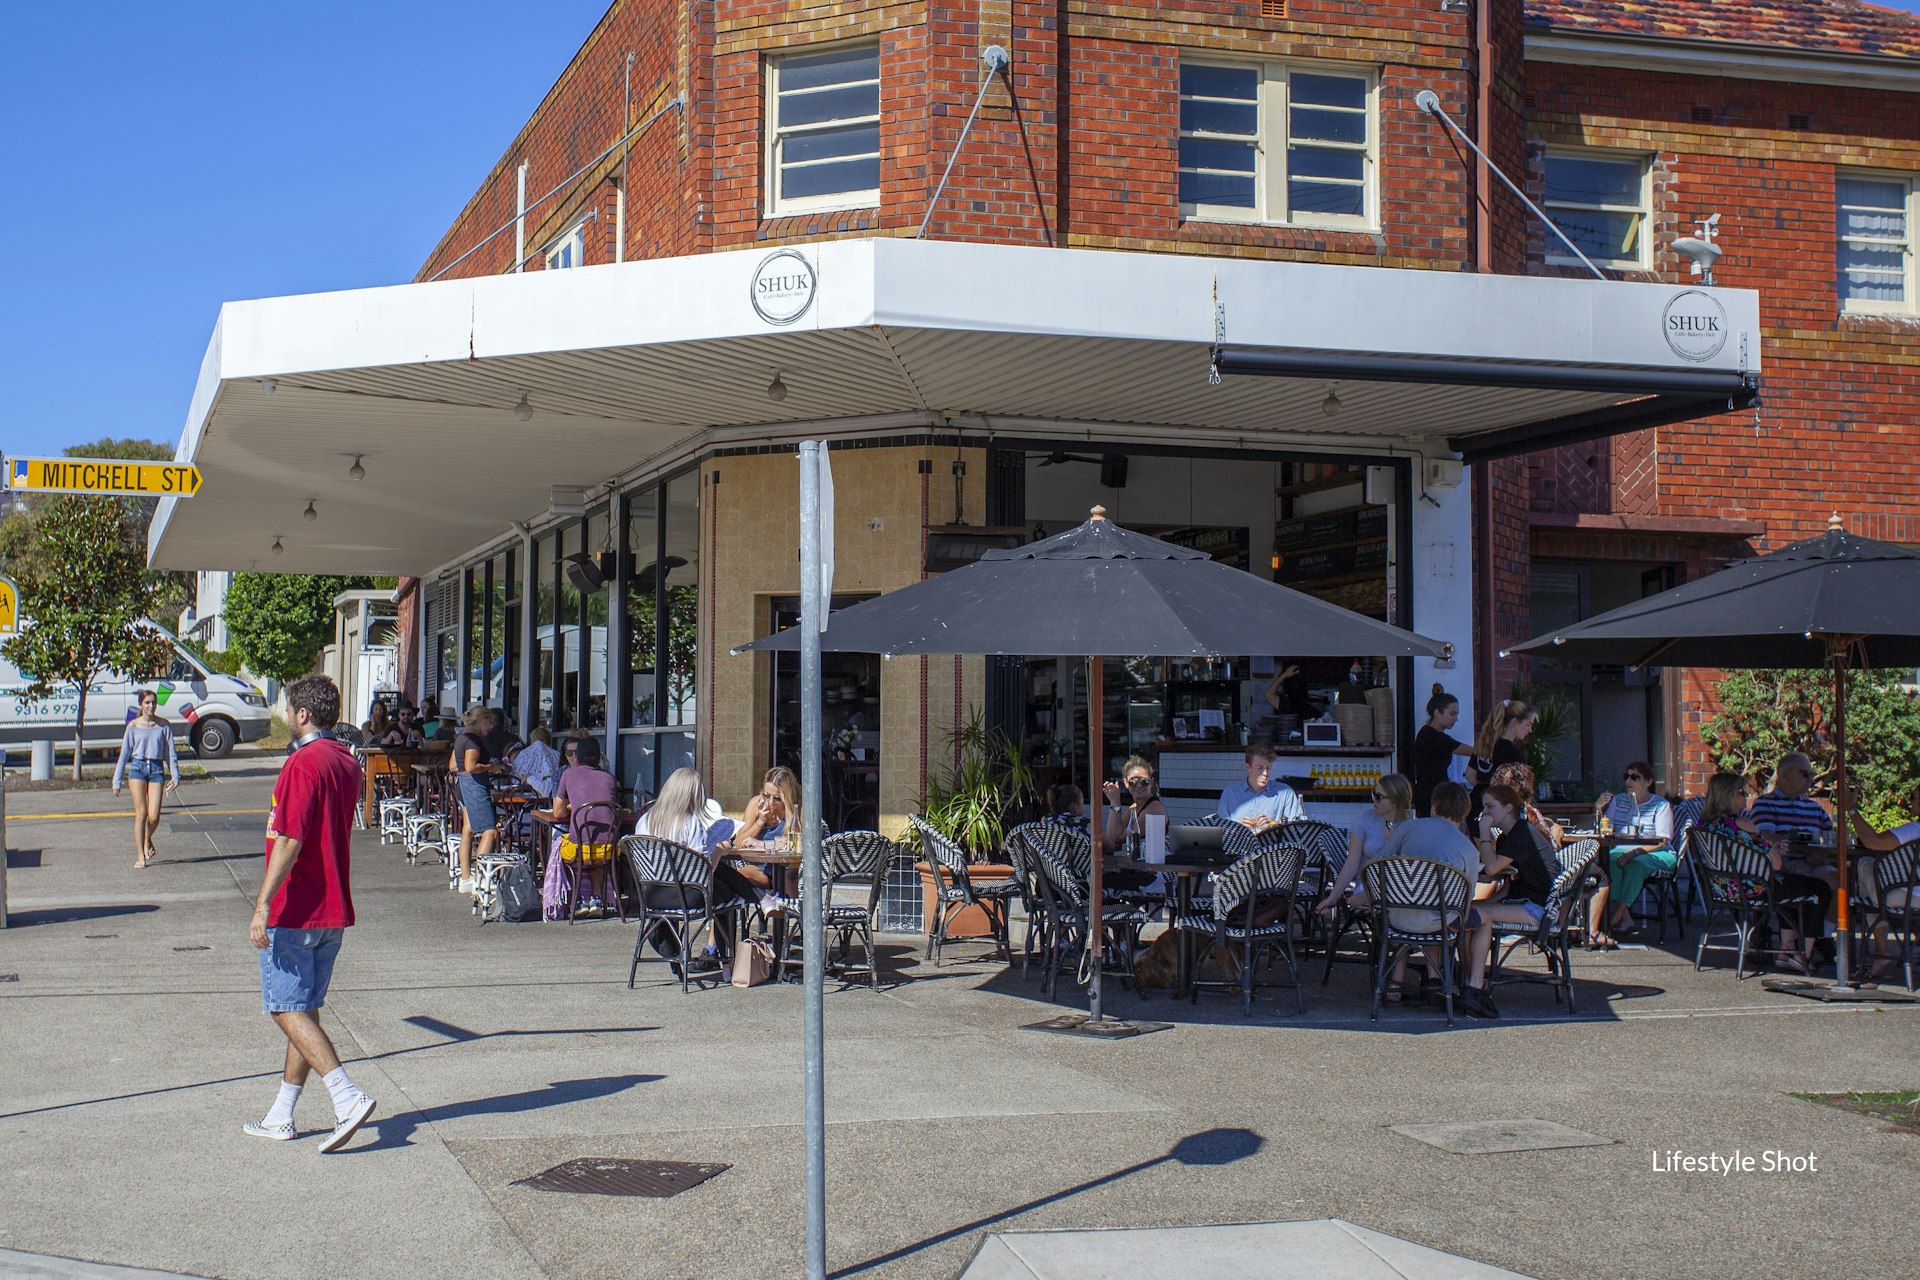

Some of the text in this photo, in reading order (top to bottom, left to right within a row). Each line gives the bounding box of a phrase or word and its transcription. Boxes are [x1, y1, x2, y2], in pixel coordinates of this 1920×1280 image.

[758, 274, 808, 293] SHUK
[1669, 315, 1720, 331] SHUK
[43, 464, 148, 491] MITCHELL
[162, 468, 188, 492] ST
[15, 703, 86, 716] 9316 979
